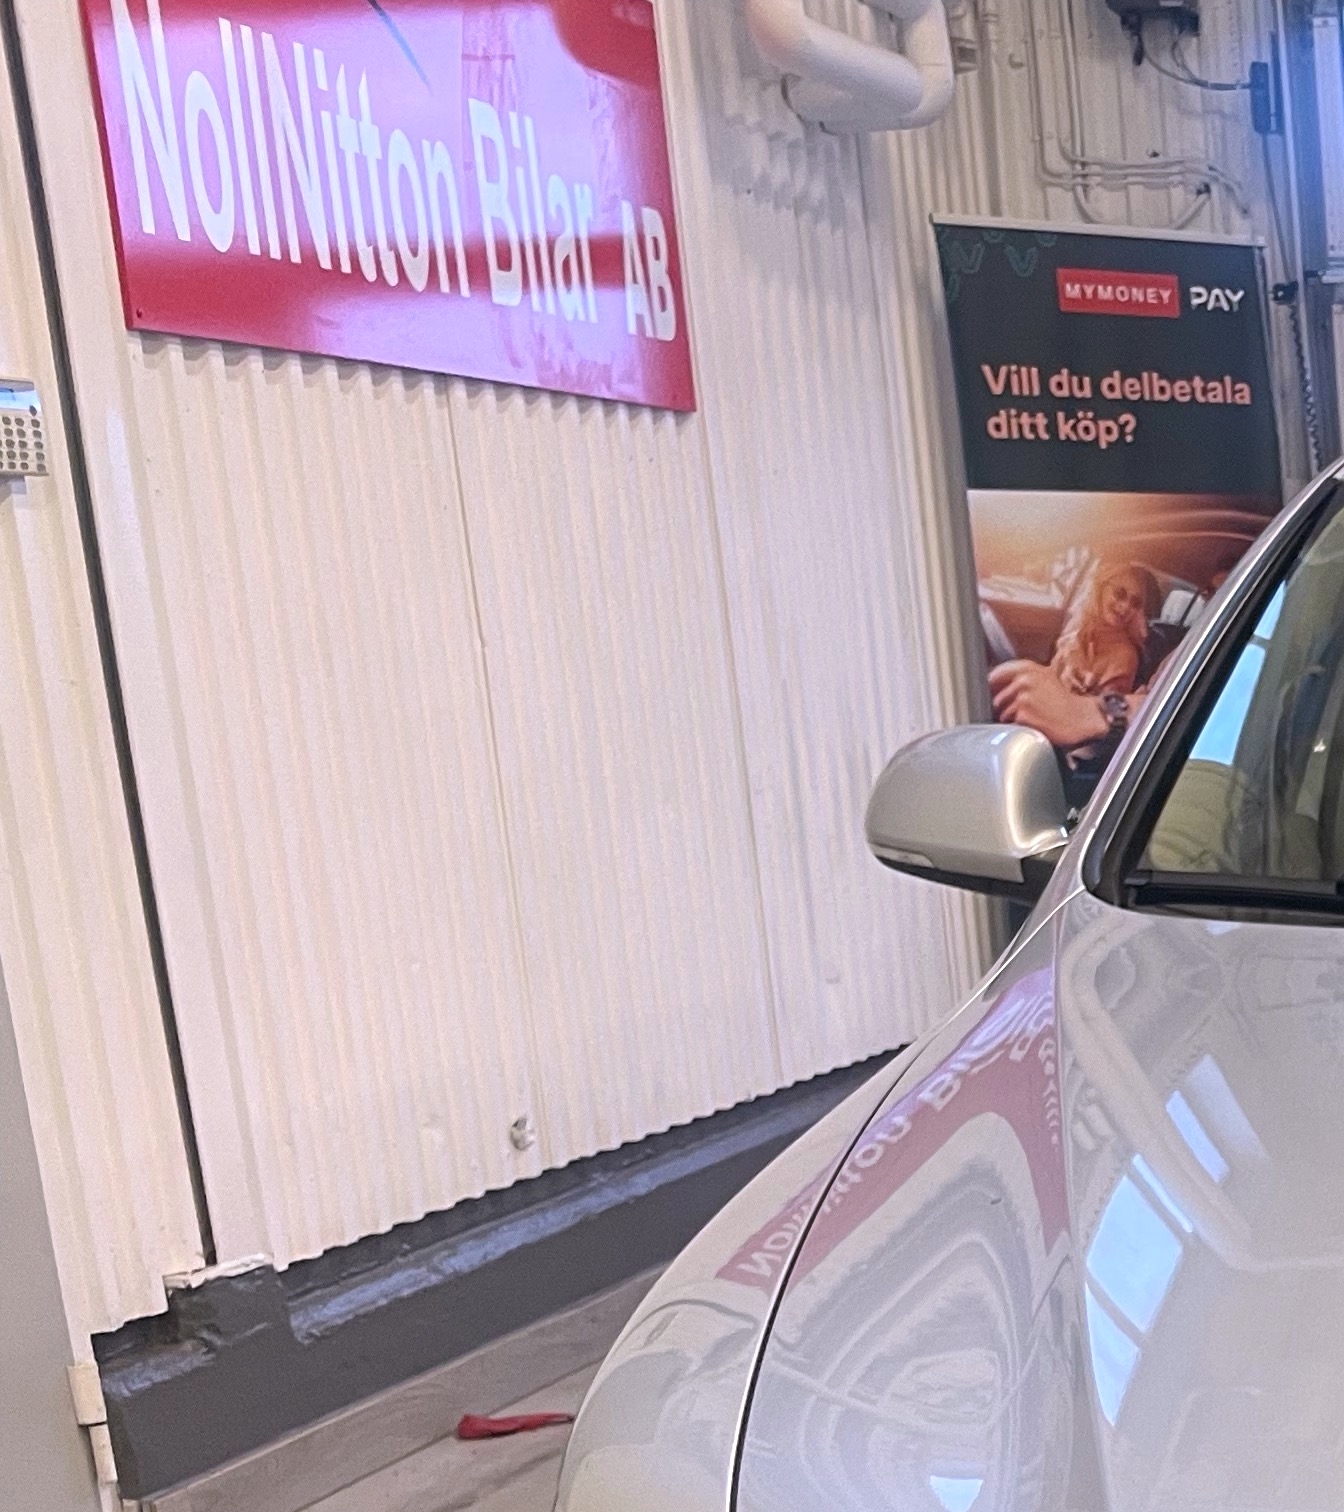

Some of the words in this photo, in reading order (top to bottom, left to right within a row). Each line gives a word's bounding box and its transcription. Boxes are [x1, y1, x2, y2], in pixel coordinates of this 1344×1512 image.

[112, 0, 470, 298] NollNitton
[468, 98, 598, 323] Bilar
[622, 200, 677, 342] AB
[1064, 282, 1172, 304] MYMONEY
[1189, 286, 1245, 312] PAY
[981, 364, 1040, 397] Vill
[1048, 368, 1092, 399] du
[1101, 371, 1252, 405] delbetala
[986, 410, 1050, 440] ditt
[1057, 411, 1137, 449] köp?
